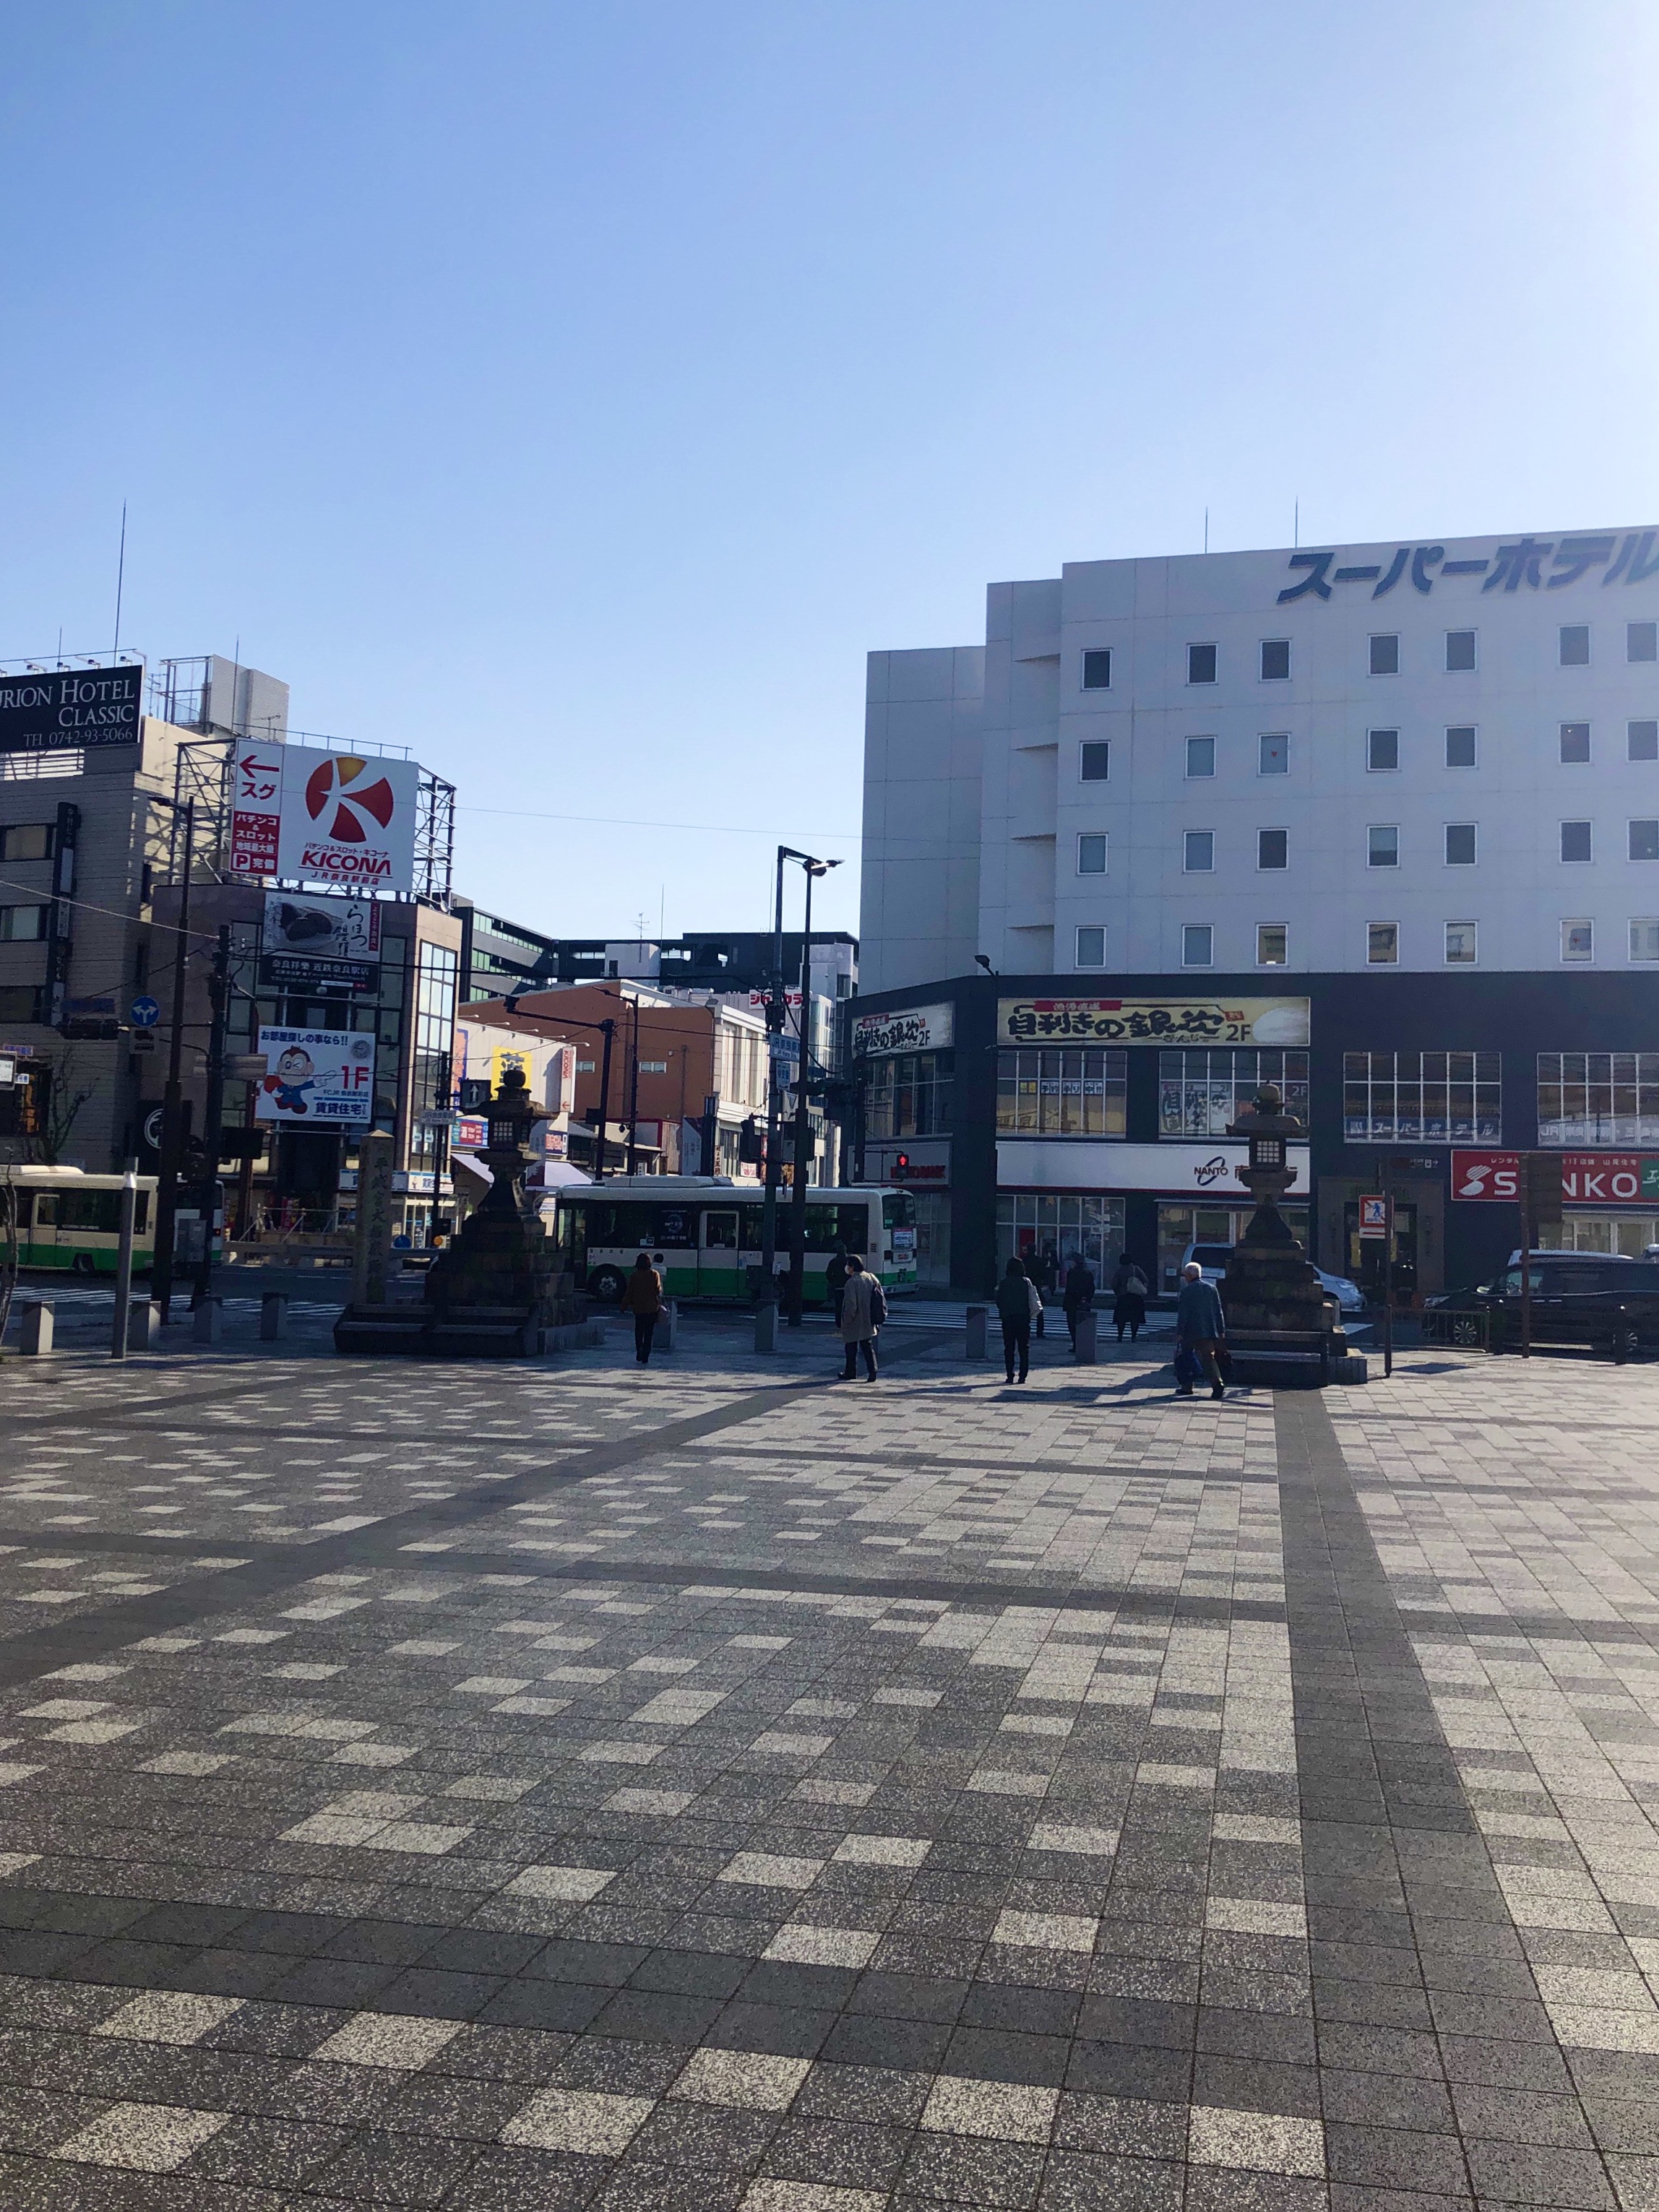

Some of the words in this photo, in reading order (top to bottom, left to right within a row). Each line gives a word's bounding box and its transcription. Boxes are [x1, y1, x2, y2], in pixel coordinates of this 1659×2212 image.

[1276, 532, 1659, 604] スーパーホテル
[60, 679, 135, 704] HOTEL
[59, 704, 134, 727] CLASSIC
[24, 733, 45, 747] TEL
[49, 727, 133, 746] 0742-93-5066
[241, 781, 277, 800] スグ
[236, 814, 277, 826] パチンコ
[236, 830, 276, 842] スロット
[253, 858, 275, 870] 完備
[301, 850, 392, 876] KICONA
[750, 994, 803, 1005] ジャカラ
[1007, 1010, 1225, 1038] 目利きの銀次
[1225, 1024, 1251, 1042] 2F
[918, 1029, 931, 1047] 2F
[342, 1066, 370, 1089] 1F
[1373, 1123, 1495, 1136] スーパーホテル
[1194, 1166, 1228, 1176] NANTO
[1494, 1172, 1637, 1198] SNKO
